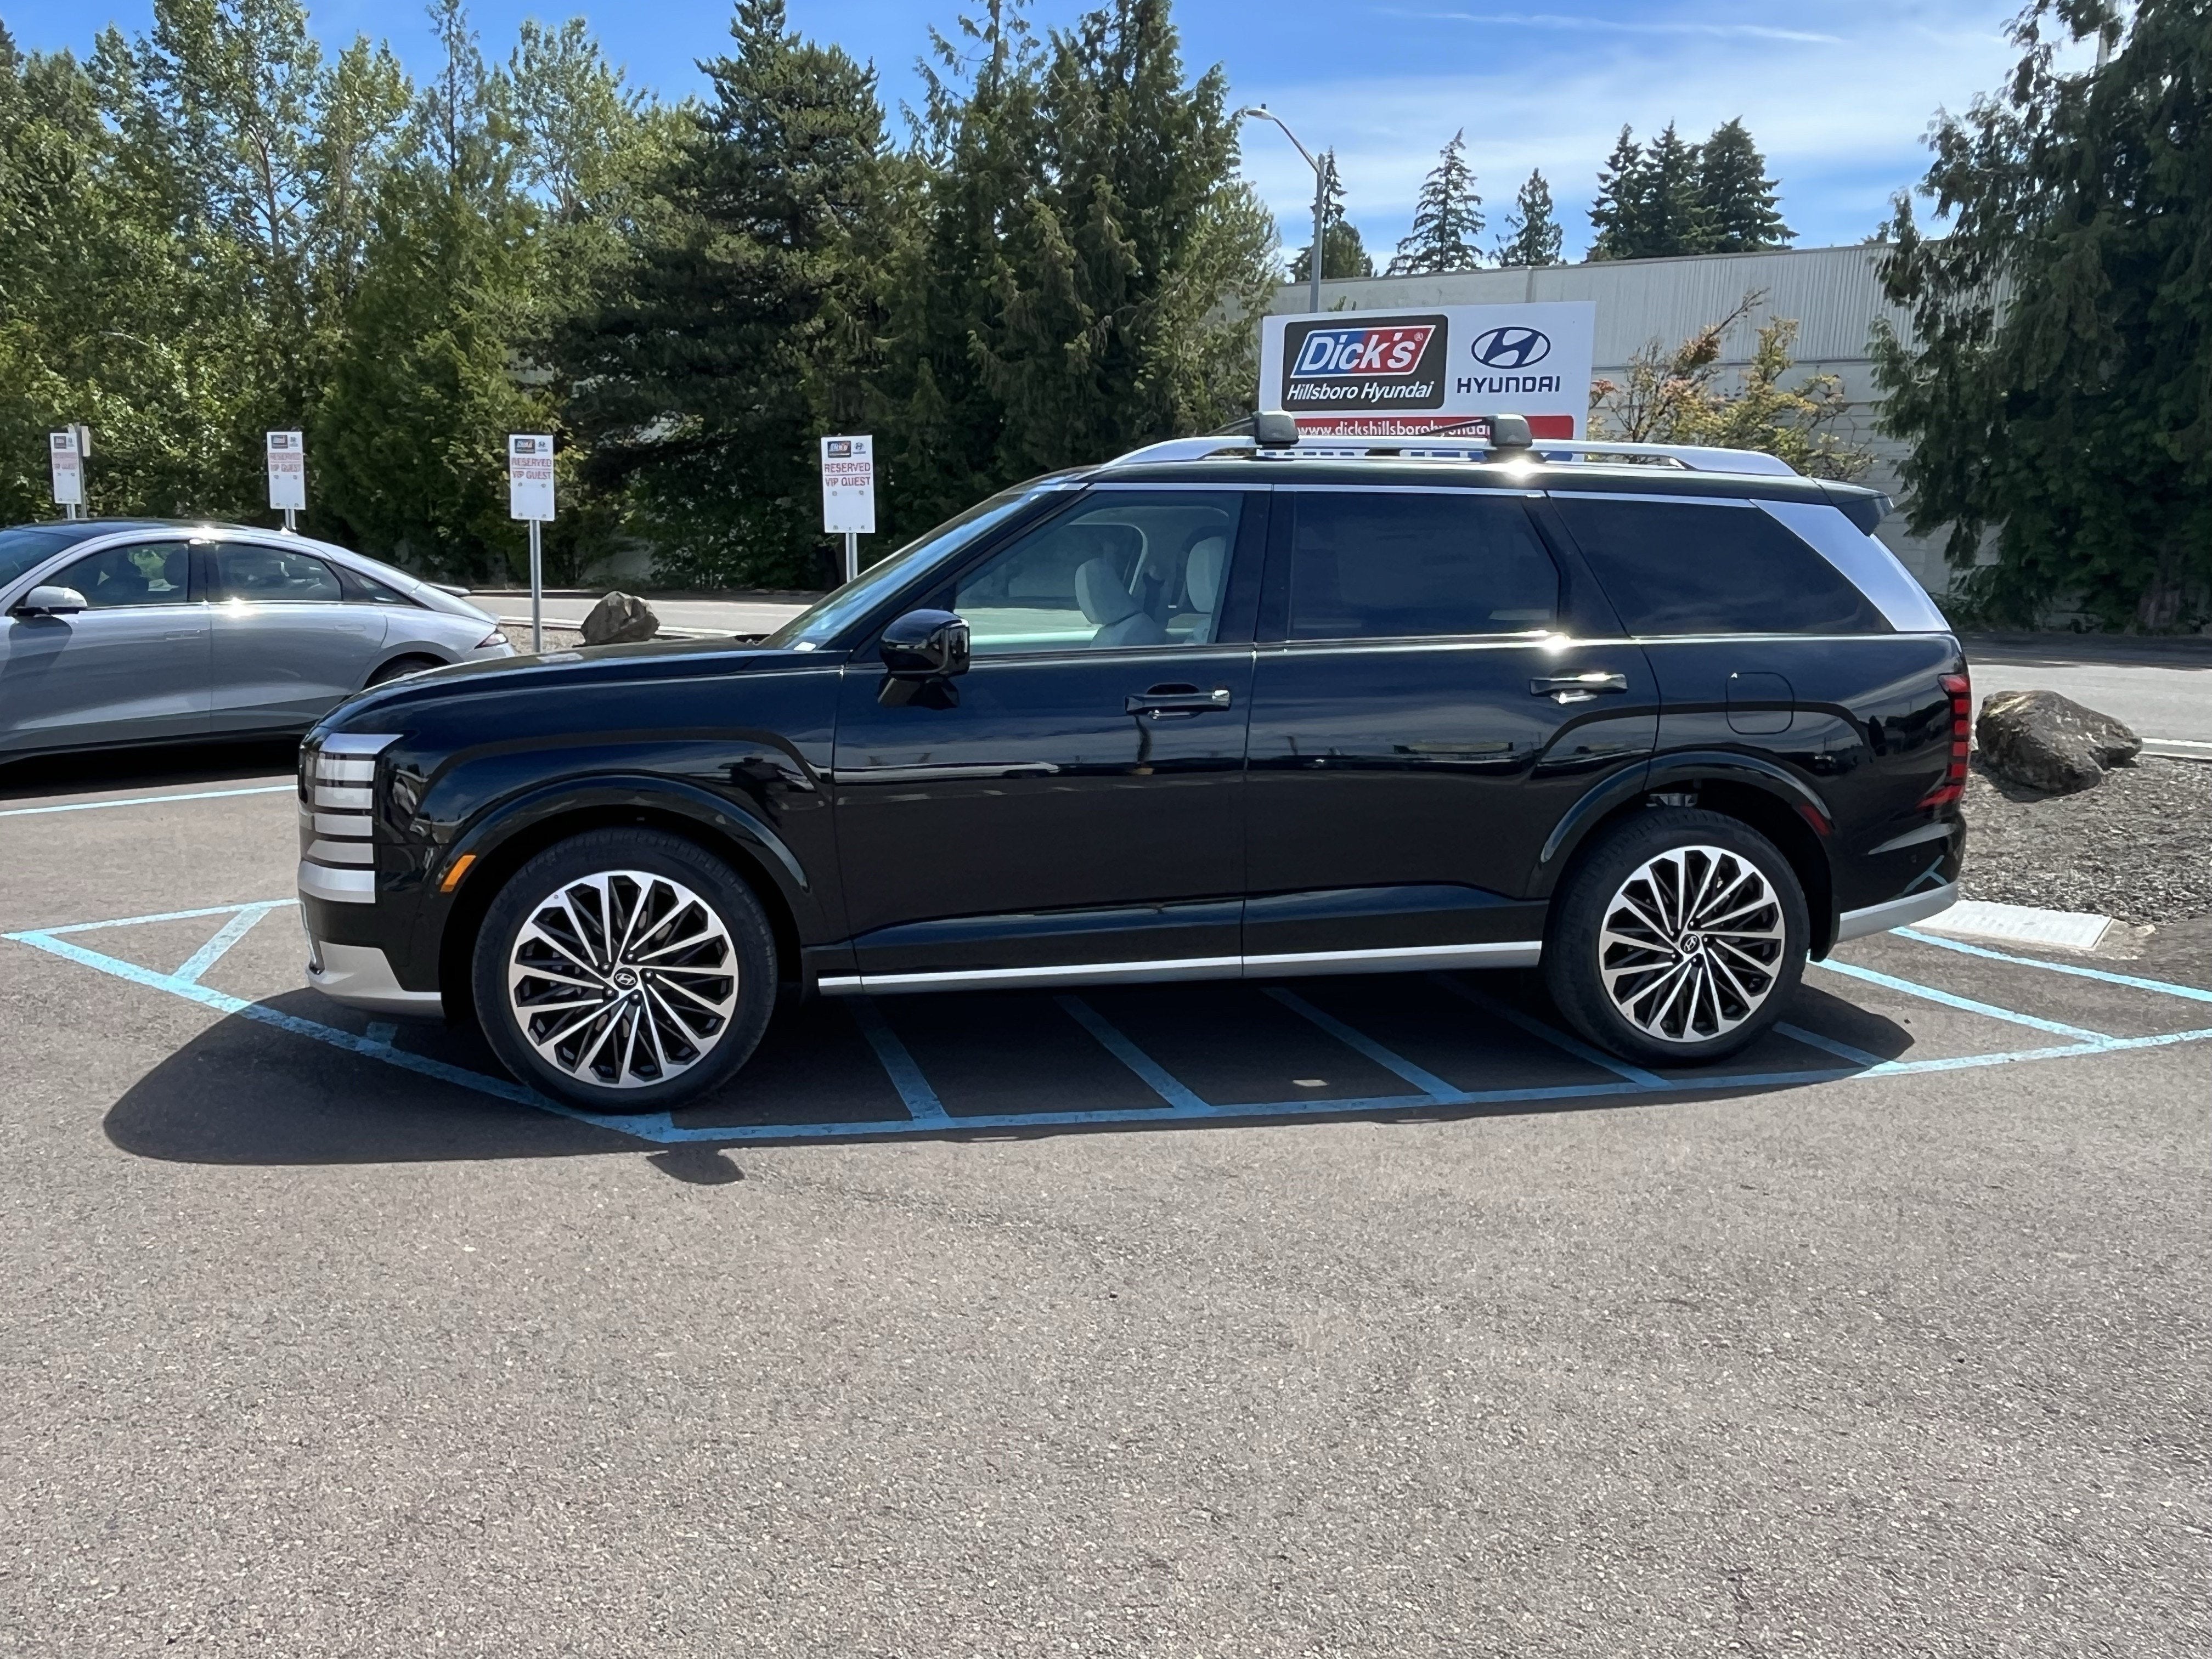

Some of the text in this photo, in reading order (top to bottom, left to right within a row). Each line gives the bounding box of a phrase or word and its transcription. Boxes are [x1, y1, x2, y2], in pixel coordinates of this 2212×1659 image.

[1457, 376, 1560, 393] HYUNDAI
[1287, 381, 1435, 403] Hillsboro Hyundai
[824, 462, 871, 472] RESERVED
[825, 477, 838, 487] VIP
